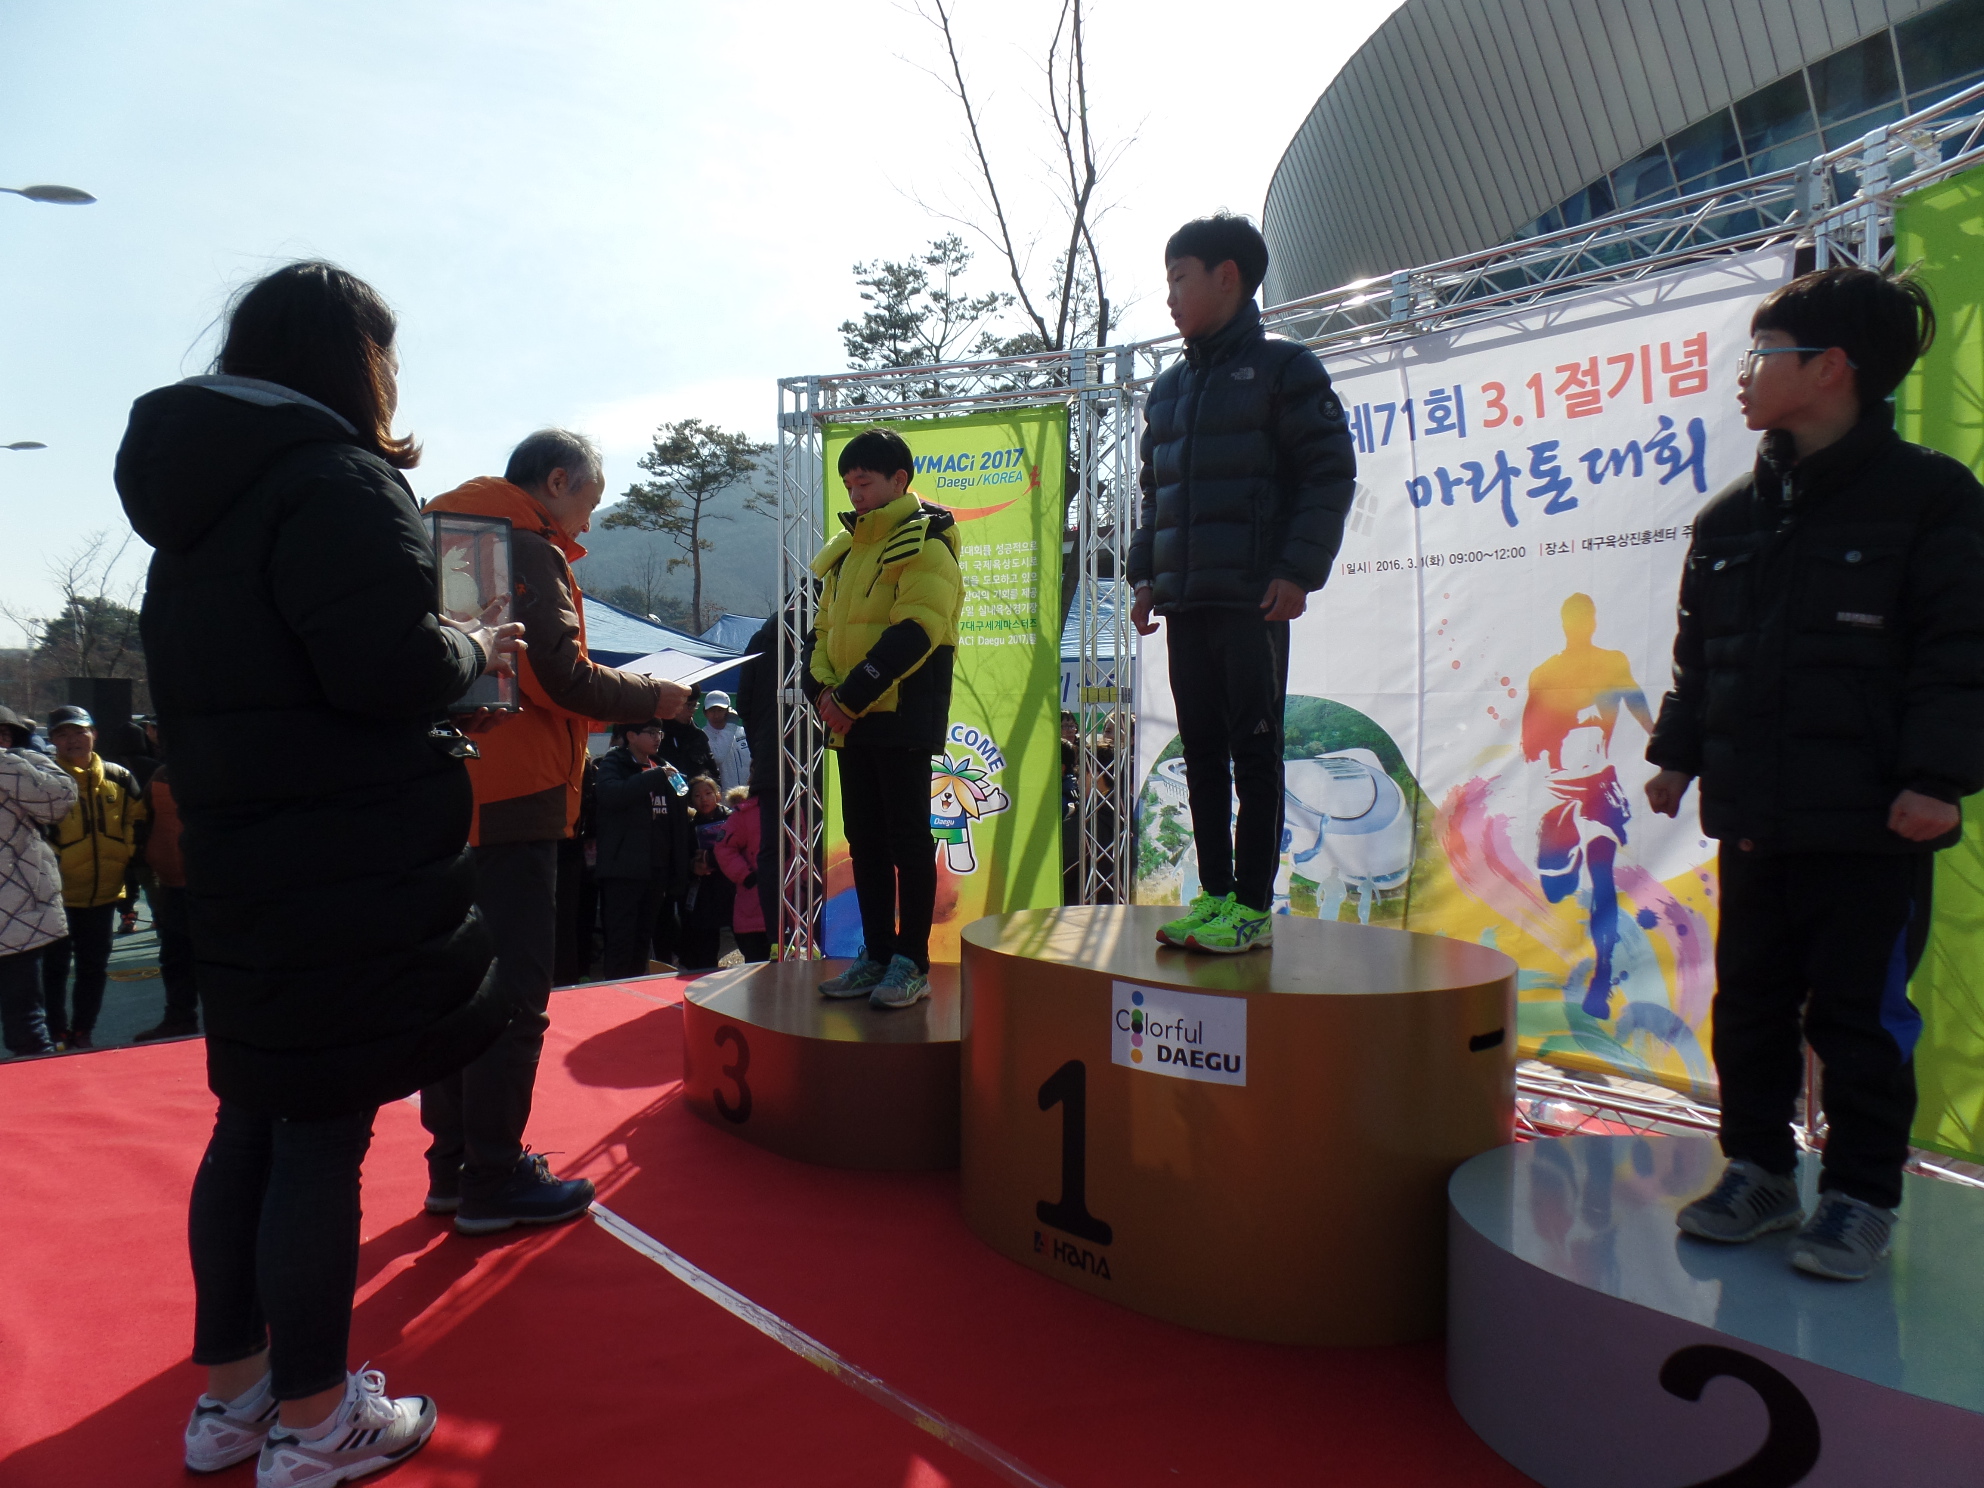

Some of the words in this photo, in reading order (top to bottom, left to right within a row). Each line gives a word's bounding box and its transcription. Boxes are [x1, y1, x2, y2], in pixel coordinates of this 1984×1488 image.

[1480, 331, 1709, 429] 3.1절기념
[979, 447, 1025, 471] 2017
[995, 541, 1038, 555] 성공적으로
[1375, 560, 1404, 572] 2016.
[1448, 546, 1527, 565] 09:00~12:00
[1581, 526, 1677, 552] 대구육상진흥센터
[973, 556, 1038, 571] 국제육상도시로
[982, 573, 1018, 585] 도모하고
[993, 588, 1018, 600] 기회를
[1021, 587, 1037, 599] 제공
[978, 602, 1038, 617] 실내육상경기장
[977, 635, 1005, 647] Daegu
[946, 725, 1005, 773] COME
[934, 817, 955, 827] Daegu
[1157, 1044, 1241, 1073] DAEGU
[713, 1025, 752, 1125] 3
[1036, 1059, 1113, 1247] 1
[1660, 1344, 1822, 1488] 2
